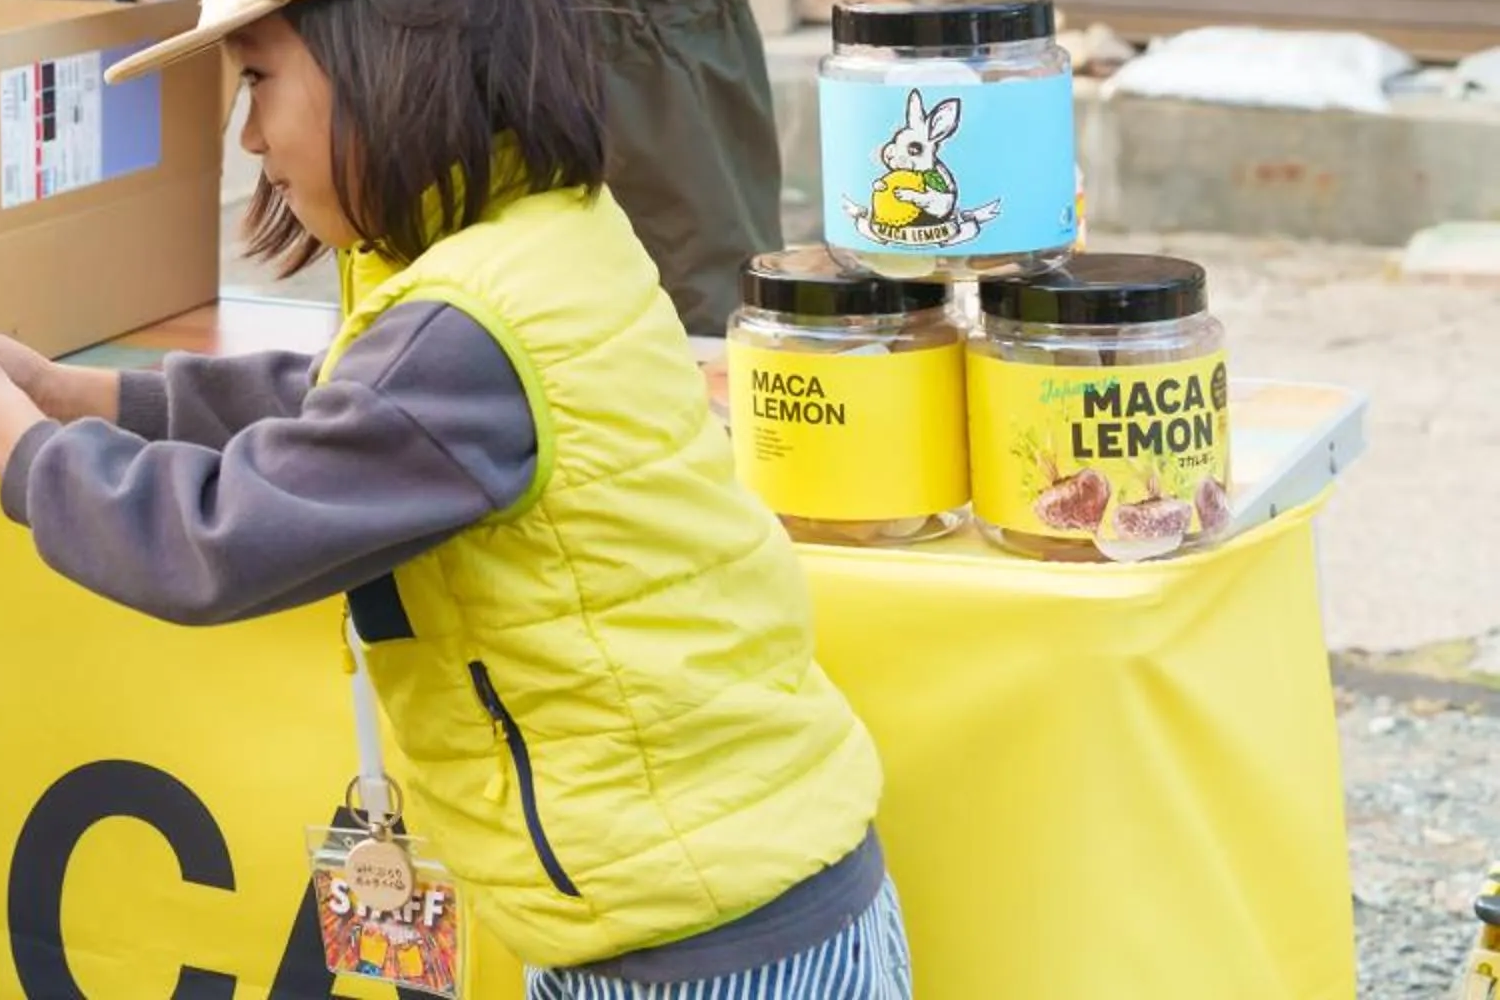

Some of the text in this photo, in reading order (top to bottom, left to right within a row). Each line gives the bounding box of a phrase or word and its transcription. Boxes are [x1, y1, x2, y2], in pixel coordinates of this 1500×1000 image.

[878, 223, 950, 243] MACA LEMON
[752, 369, 825, 398] MACA
[1083, 375, 1205, 418] MACA
[753, 394, 845, 425] LEMON
[1072, 413, 1213, 459] LEMON
